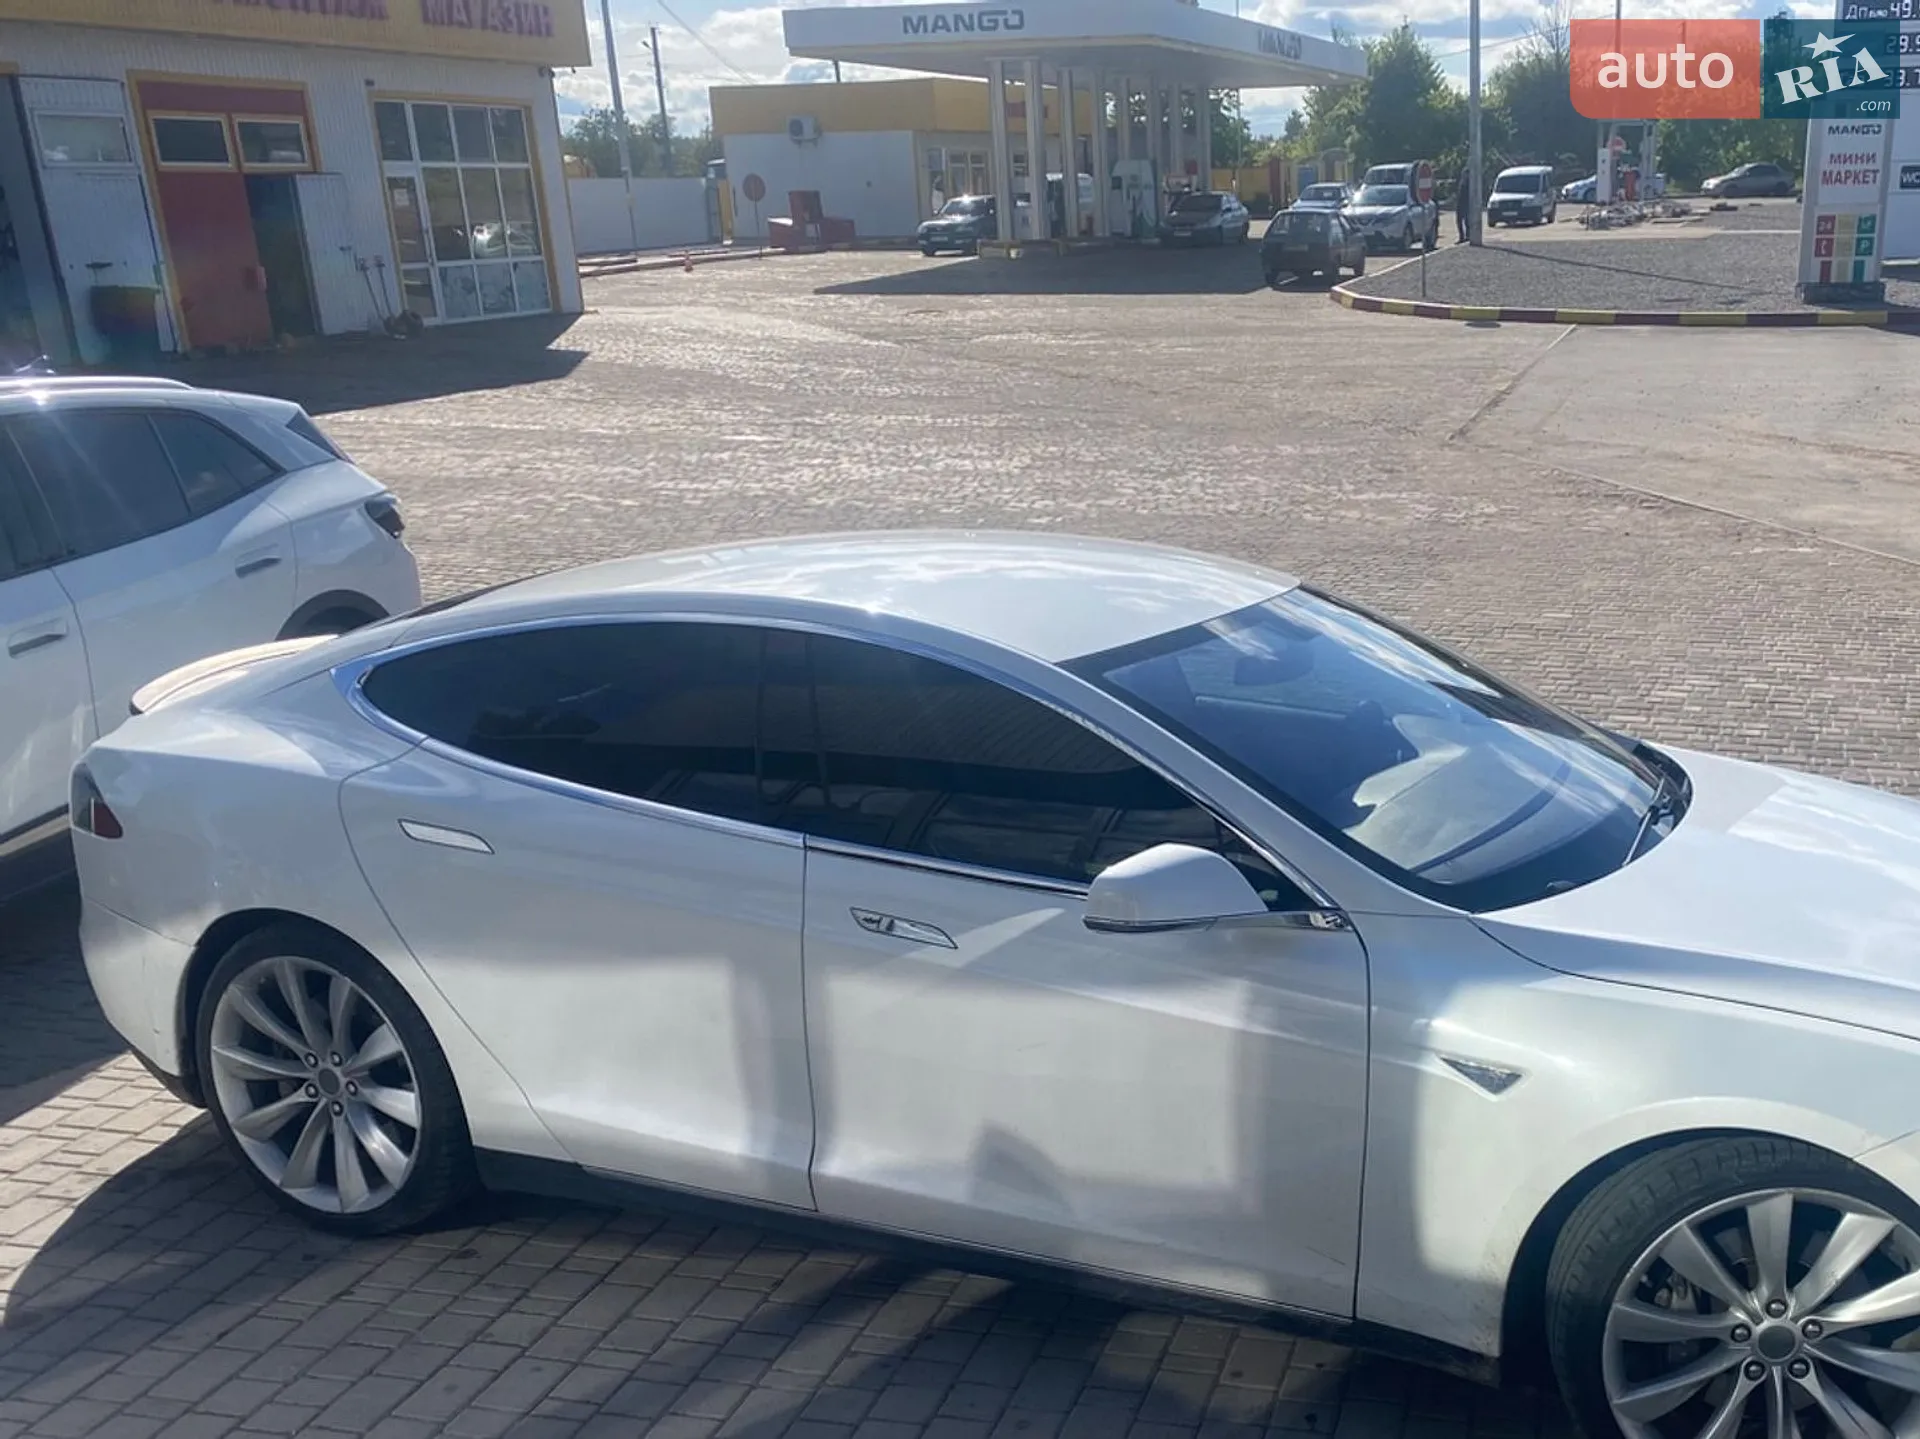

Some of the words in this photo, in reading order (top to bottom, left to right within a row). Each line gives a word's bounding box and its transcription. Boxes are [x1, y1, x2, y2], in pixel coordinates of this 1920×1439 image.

[1890, 0, 1920, 18] 49.
[902, 9, 1025, 34] MANGO
[1827, 124, 1882, 135] MANGO
[1829, 152, 1877, 165] МИНИ
[1821, 169, 1880, 187] МАРКЕТ
